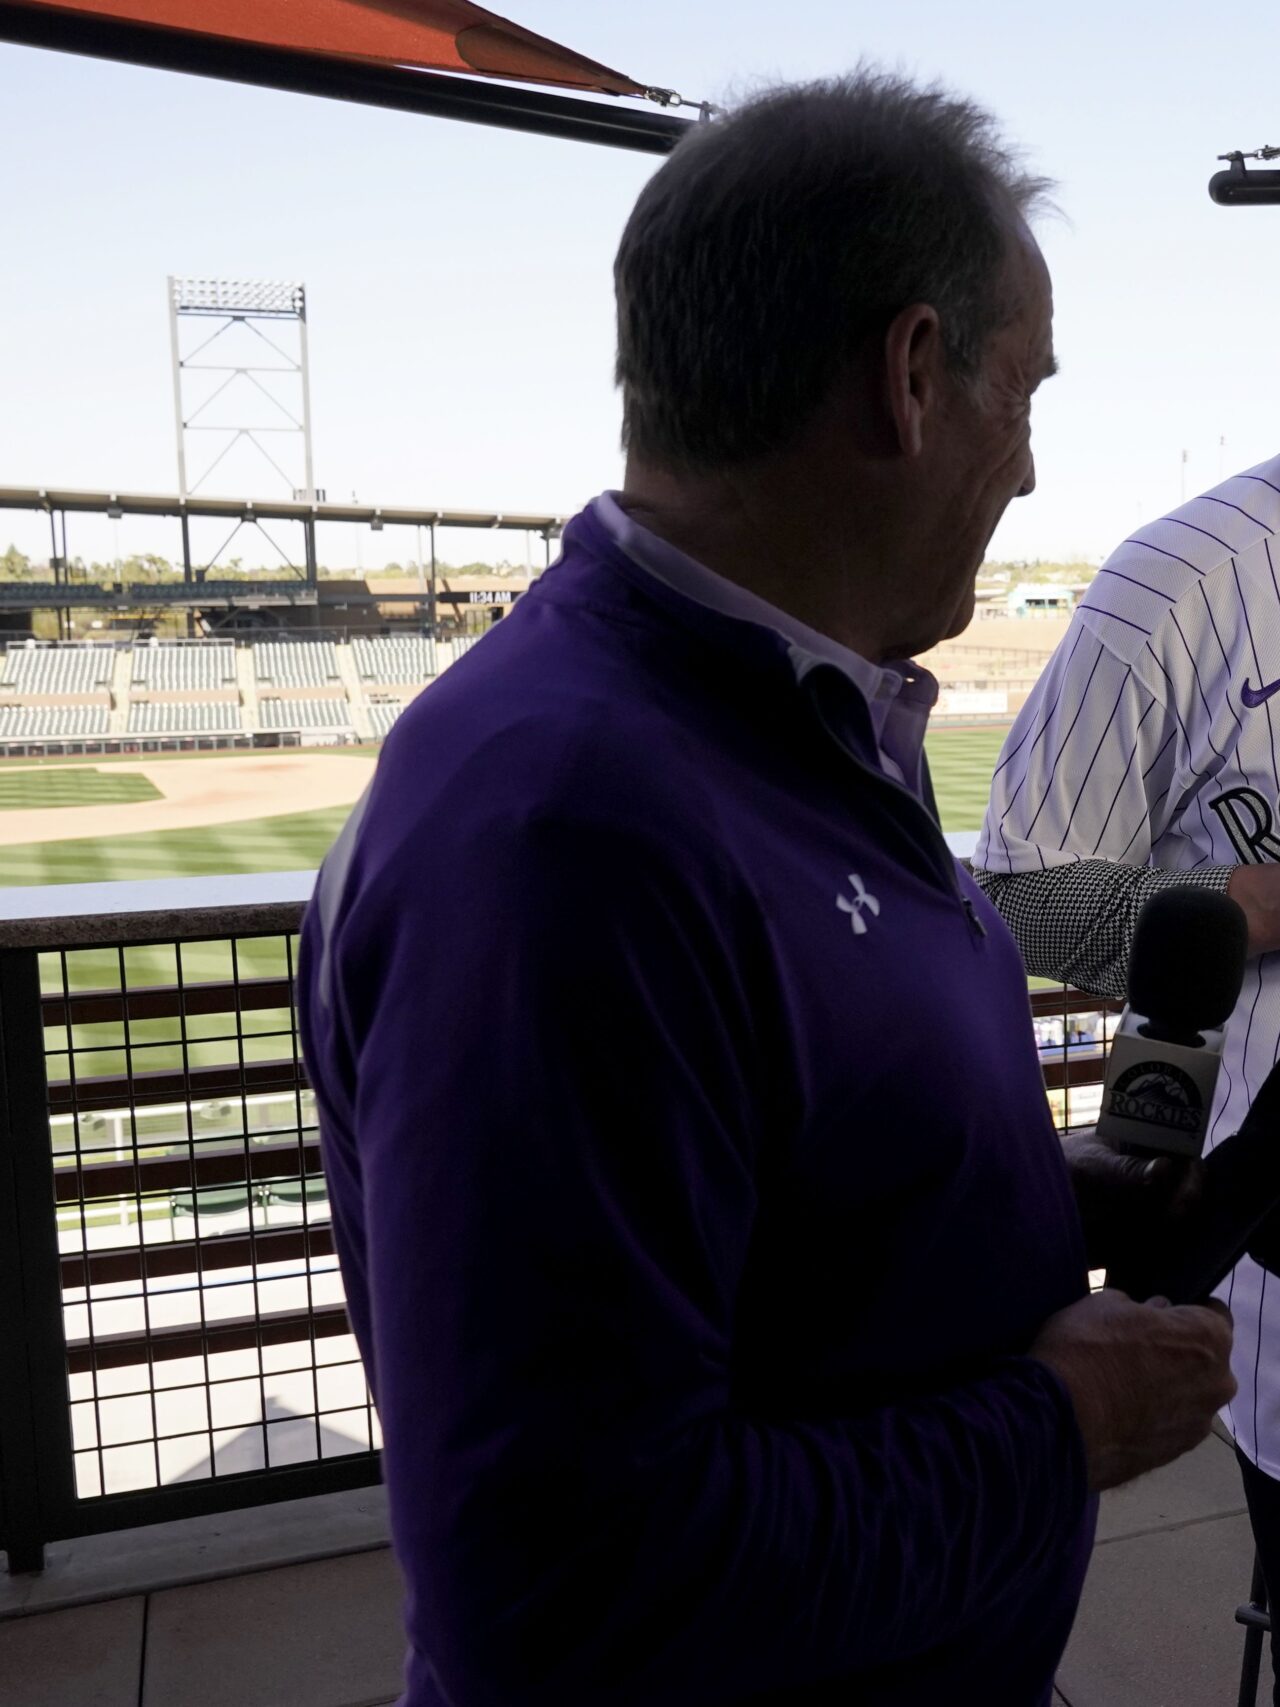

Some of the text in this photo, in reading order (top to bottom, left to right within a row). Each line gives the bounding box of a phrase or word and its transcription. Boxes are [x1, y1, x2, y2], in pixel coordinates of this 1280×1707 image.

[469, 591, 512, 604] 11:34 AM
[1111, 1061, 1200, 1102] COLORA
[1110, 1091, 1202, 1130] ROCKIES
